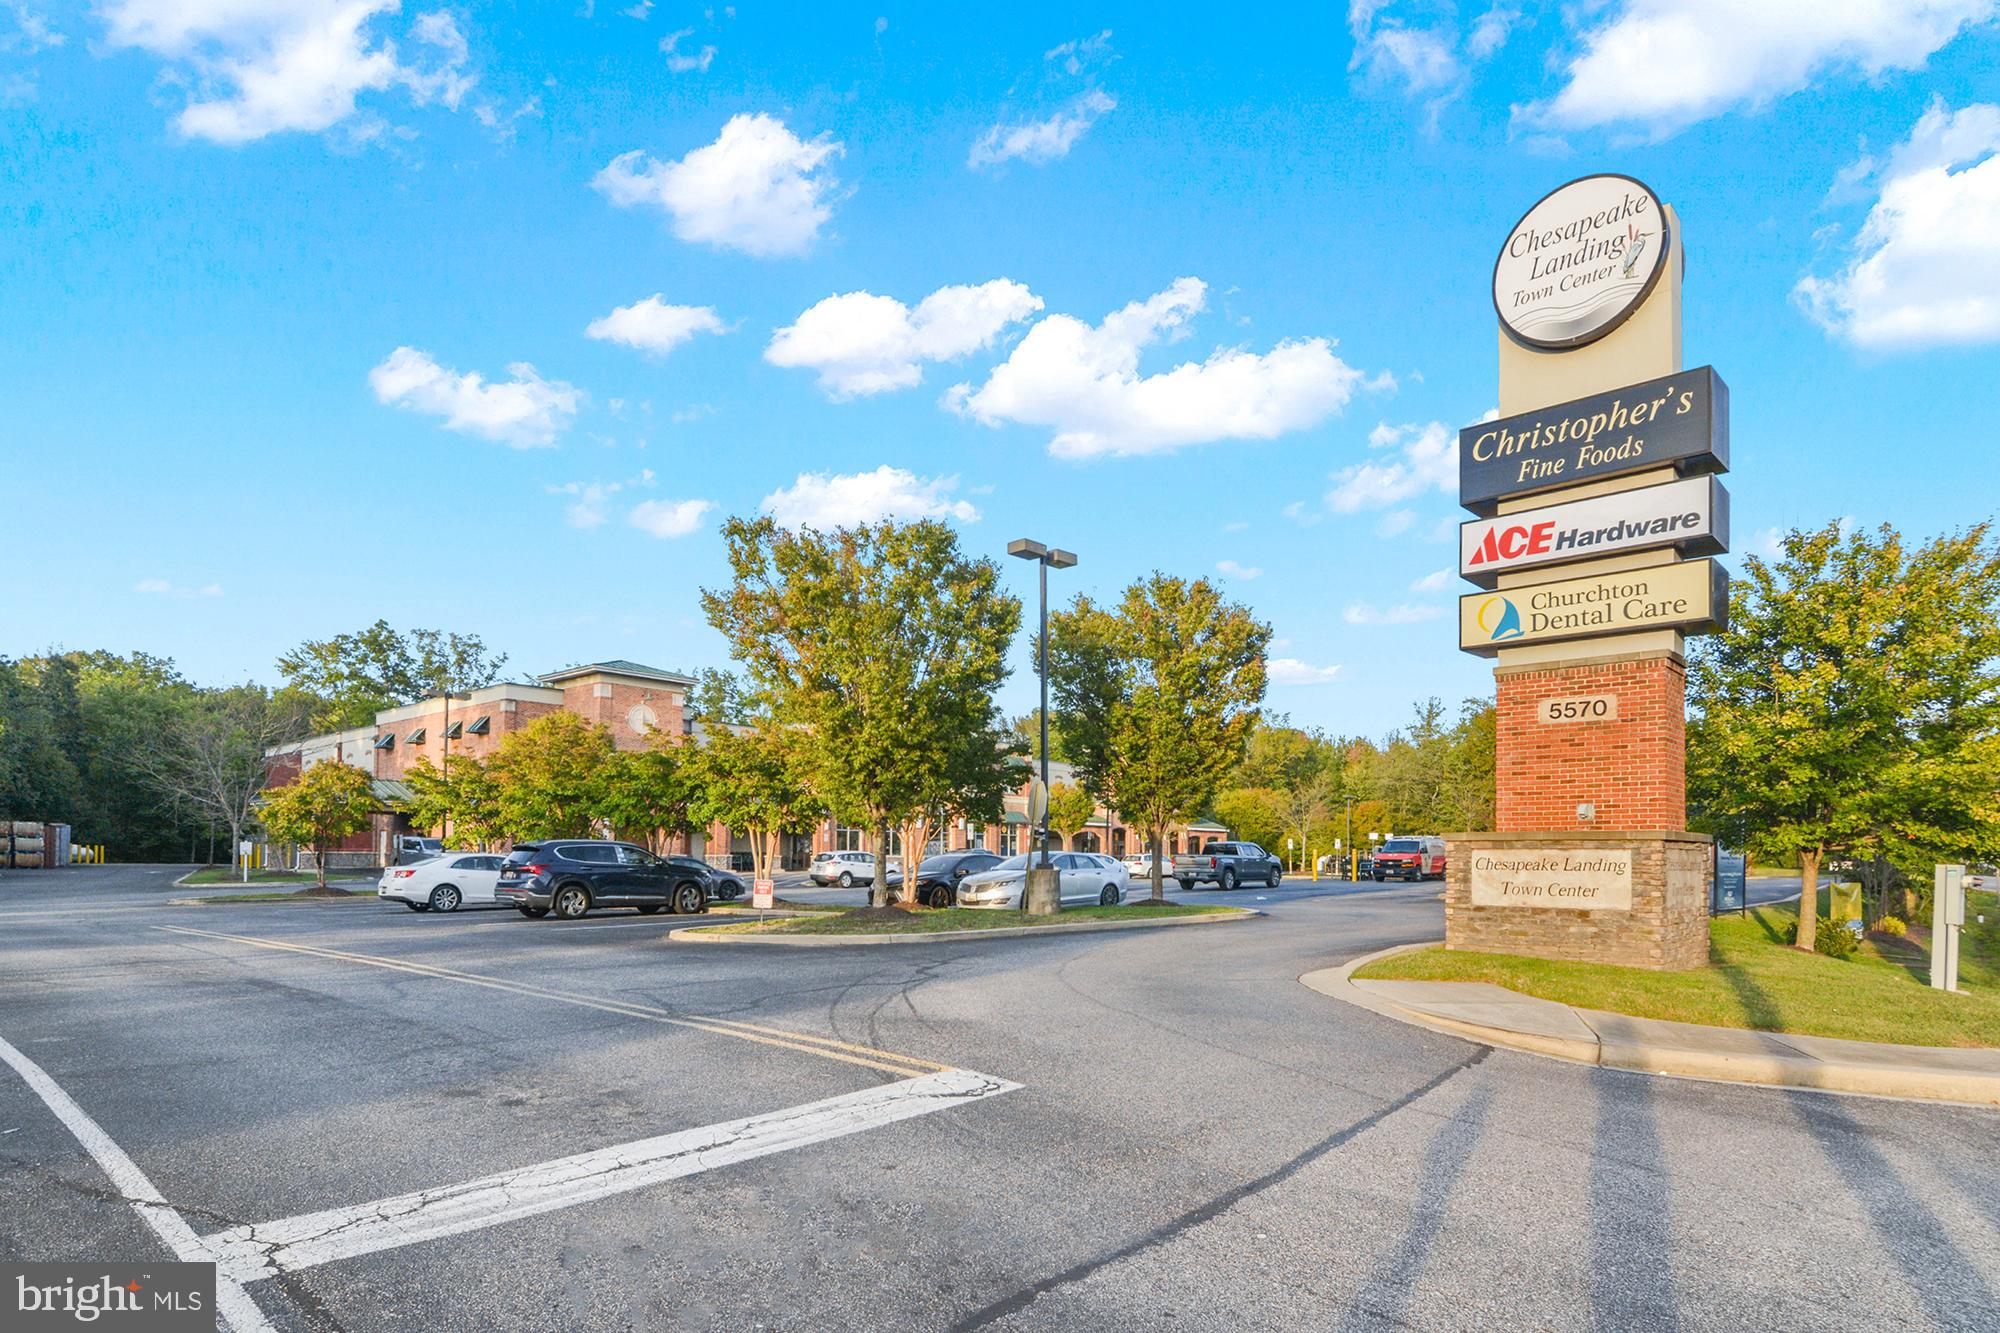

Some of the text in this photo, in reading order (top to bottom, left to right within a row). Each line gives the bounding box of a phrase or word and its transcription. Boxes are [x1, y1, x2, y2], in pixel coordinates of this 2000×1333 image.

[1509, 193, 1648, 258] Chesapeake
[1529, 234, 1627, 281] Landing
[1512, 263, 1616, 308] Town Center
[1472, 386, 1694, 462] Christopher's
[1517, 435, 1644, 483] Fine Foods
[1468, 511, 1701, 566] ACE Hardware
[1530, 582, 1649, 610] Churchton
[1530, 598, 1688, 632] Dental Care
[1548, 699, 1608, 720] 5570
[1475, 856, 1627, 875] Chesapeake Landing
[1501, 881, 1599, 898] Town Center
